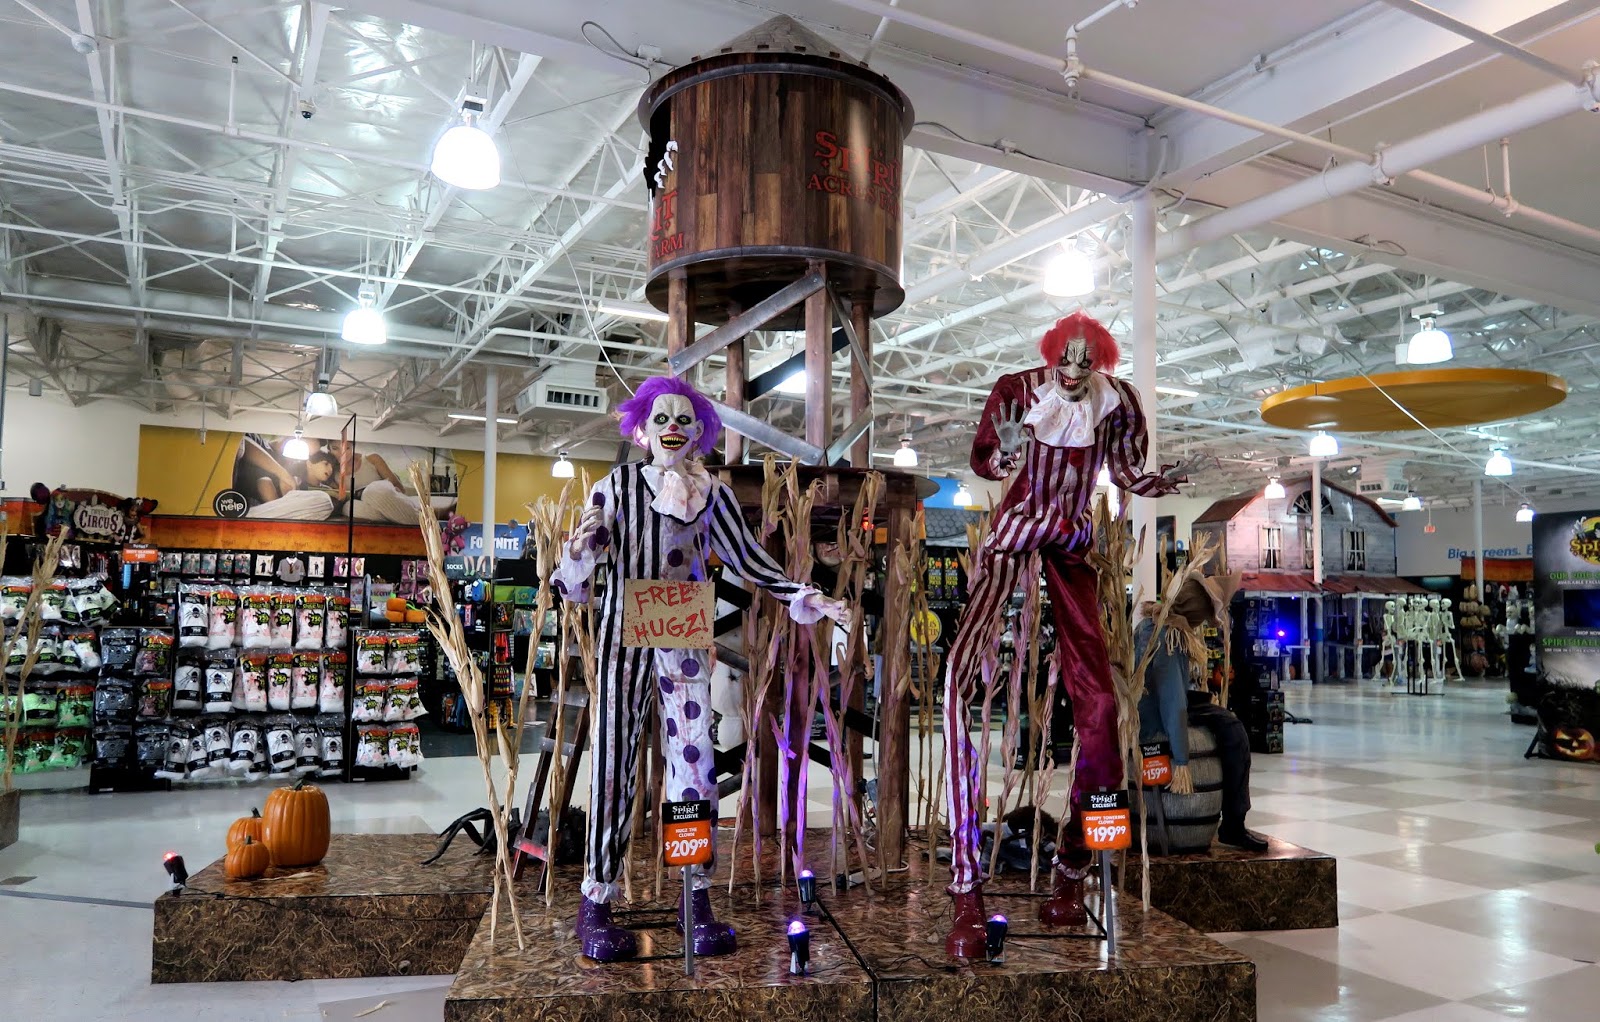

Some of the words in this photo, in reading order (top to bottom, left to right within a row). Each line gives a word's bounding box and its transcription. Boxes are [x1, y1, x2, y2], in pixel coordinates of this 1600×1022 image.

[220, 502, 244, 512] help
[79, 509, 119, 532] CIRCUS
[470, 535, 519, 551] FOTNITE
[1471, 547, 1521, 557] sreens.
[634, 582, 693, 615] FREE
[633, 609, 708, 646] HUGZ!
[1090, 793, 1118, 803] SPIRIT
[672, 802, 700, 814] SPIRIT
